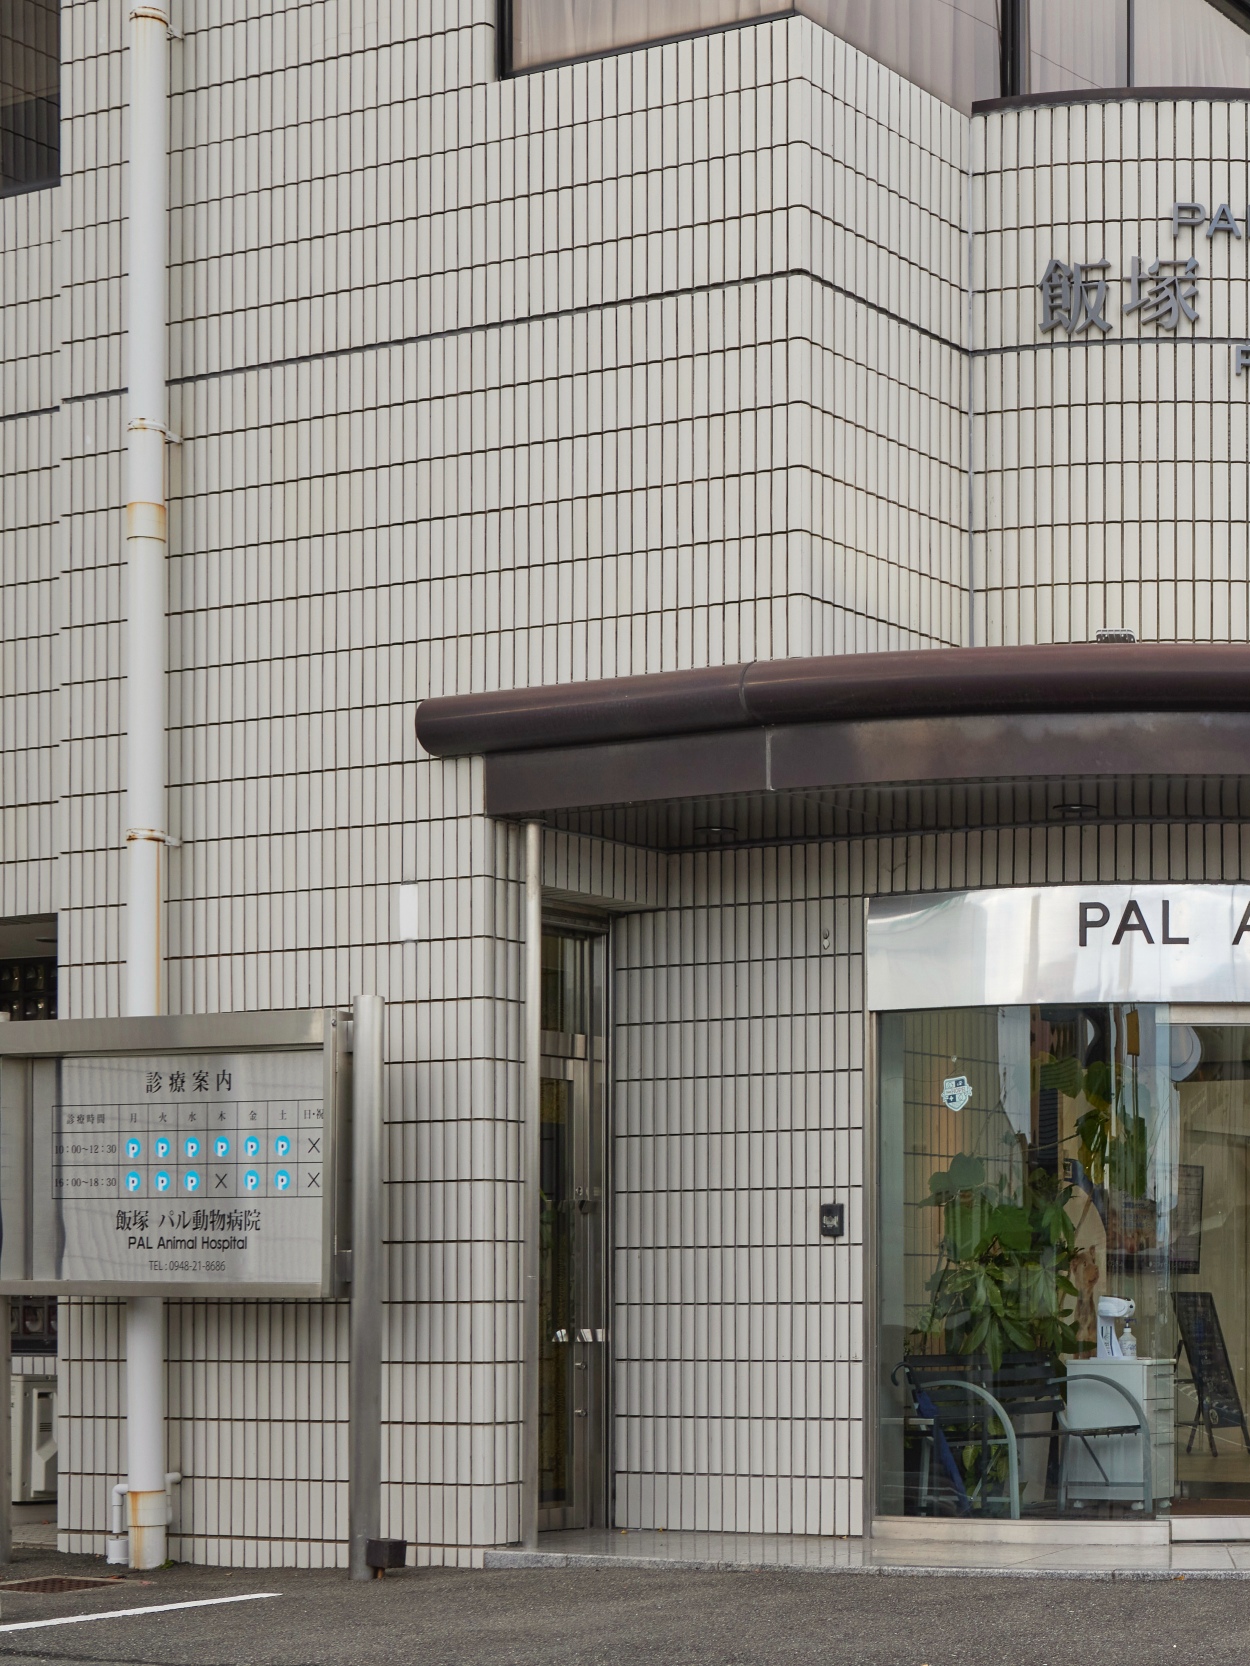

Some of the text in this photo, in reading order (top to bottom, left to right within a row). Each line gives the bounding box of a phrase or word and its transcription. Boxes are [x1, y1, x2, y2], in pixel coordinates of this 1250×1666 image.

[1038, 254, 1200, 335] 飯塚
[1078, 899, 1190, 947] PAL
[146, 1069, 233, 1094] 診療案内
[67, 1112, 106, 1125] 診療時間
[130, 1113, 138, 1123] 月
[158, 1112, 167, 1123] 火
[188, 1111, 197, 1122] 水
[217, 1110, 226, 1121] 木
[248, 1110, 257, 1121] 金
[279, 1110, 287, 1121] 土
[115, 1209, 261, 1231] 飯塚 パル動物病院
[128, 1236, 247, 1252] PAL Animal Hospital
